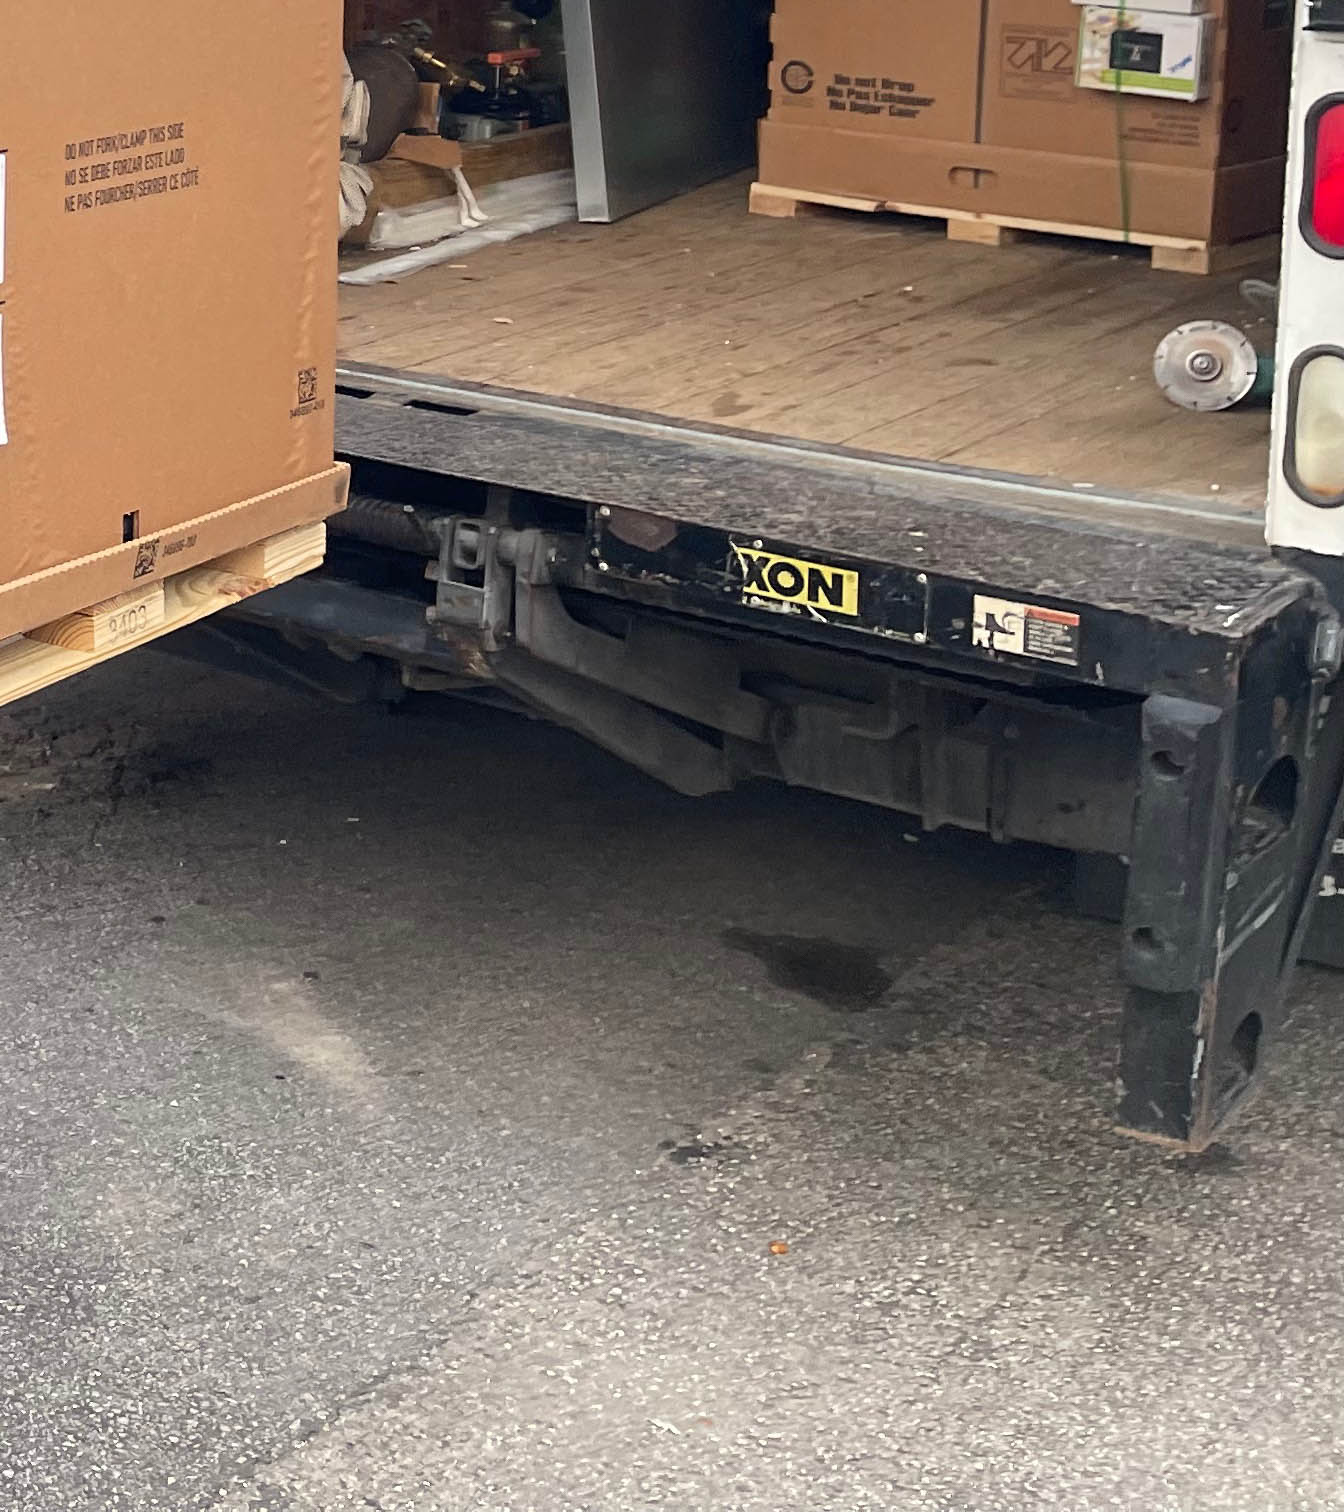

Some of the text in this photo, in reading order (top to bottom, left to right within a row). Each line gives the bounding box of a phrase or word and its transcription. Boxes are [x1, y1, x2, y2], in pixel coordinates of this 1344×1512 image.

[65, 143, 76, 161] DO
[78, 139, 94, 157] NOT
[148, 126, 166, 144] THIS
[167, 122, 184, 140] SIDE
[65, 169, 76, 186] NO
[78, 166, 89, 184] SE
[145, 151, 164, 170] ESTE
[165, 147, 185, 166] LADO
[77, 191, 93, 210] PAS
[169, 173, 179, 191] CE
